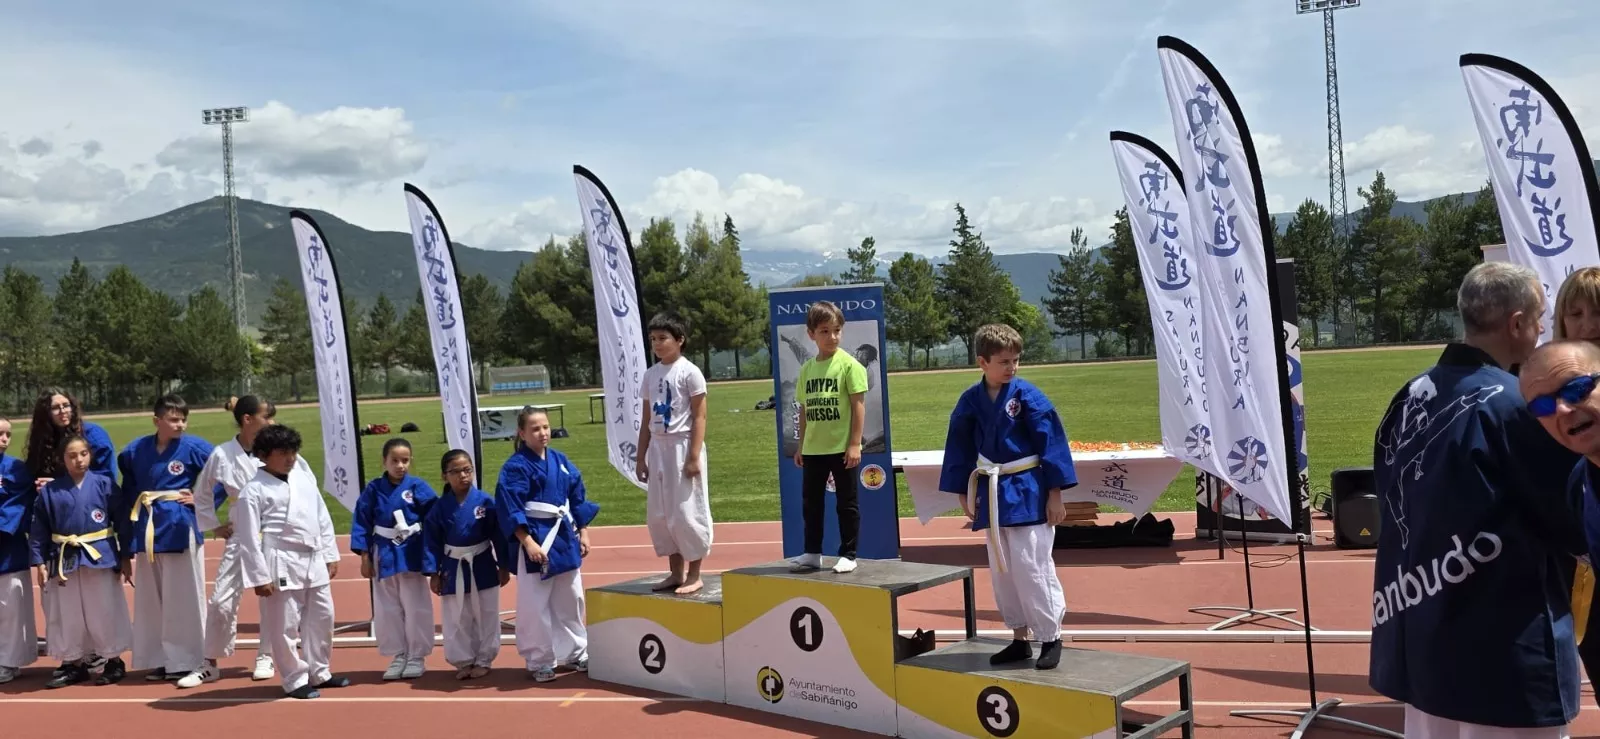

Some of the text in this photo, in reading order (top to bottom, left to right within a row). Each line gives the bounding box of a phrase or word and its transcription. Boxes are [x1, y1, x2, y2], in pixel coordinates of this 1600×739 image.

[776, 299, 876, 315] NAUDO
[806, 378, 839, 393] AMYPA
[806, 407, 841, 421] HUESCA
[1091, 489, 1139, 501] NANBUDO
[1096, 493, 1134, 505] SAKURA
[1372, 531, 1503, 627] anbudo
[798, 613, 813, 645] 1
[645, 639, 661, 668] 2
[789, 677, 856, 698] Ayuntamiento
[986, 693, 1011, 730] 3
